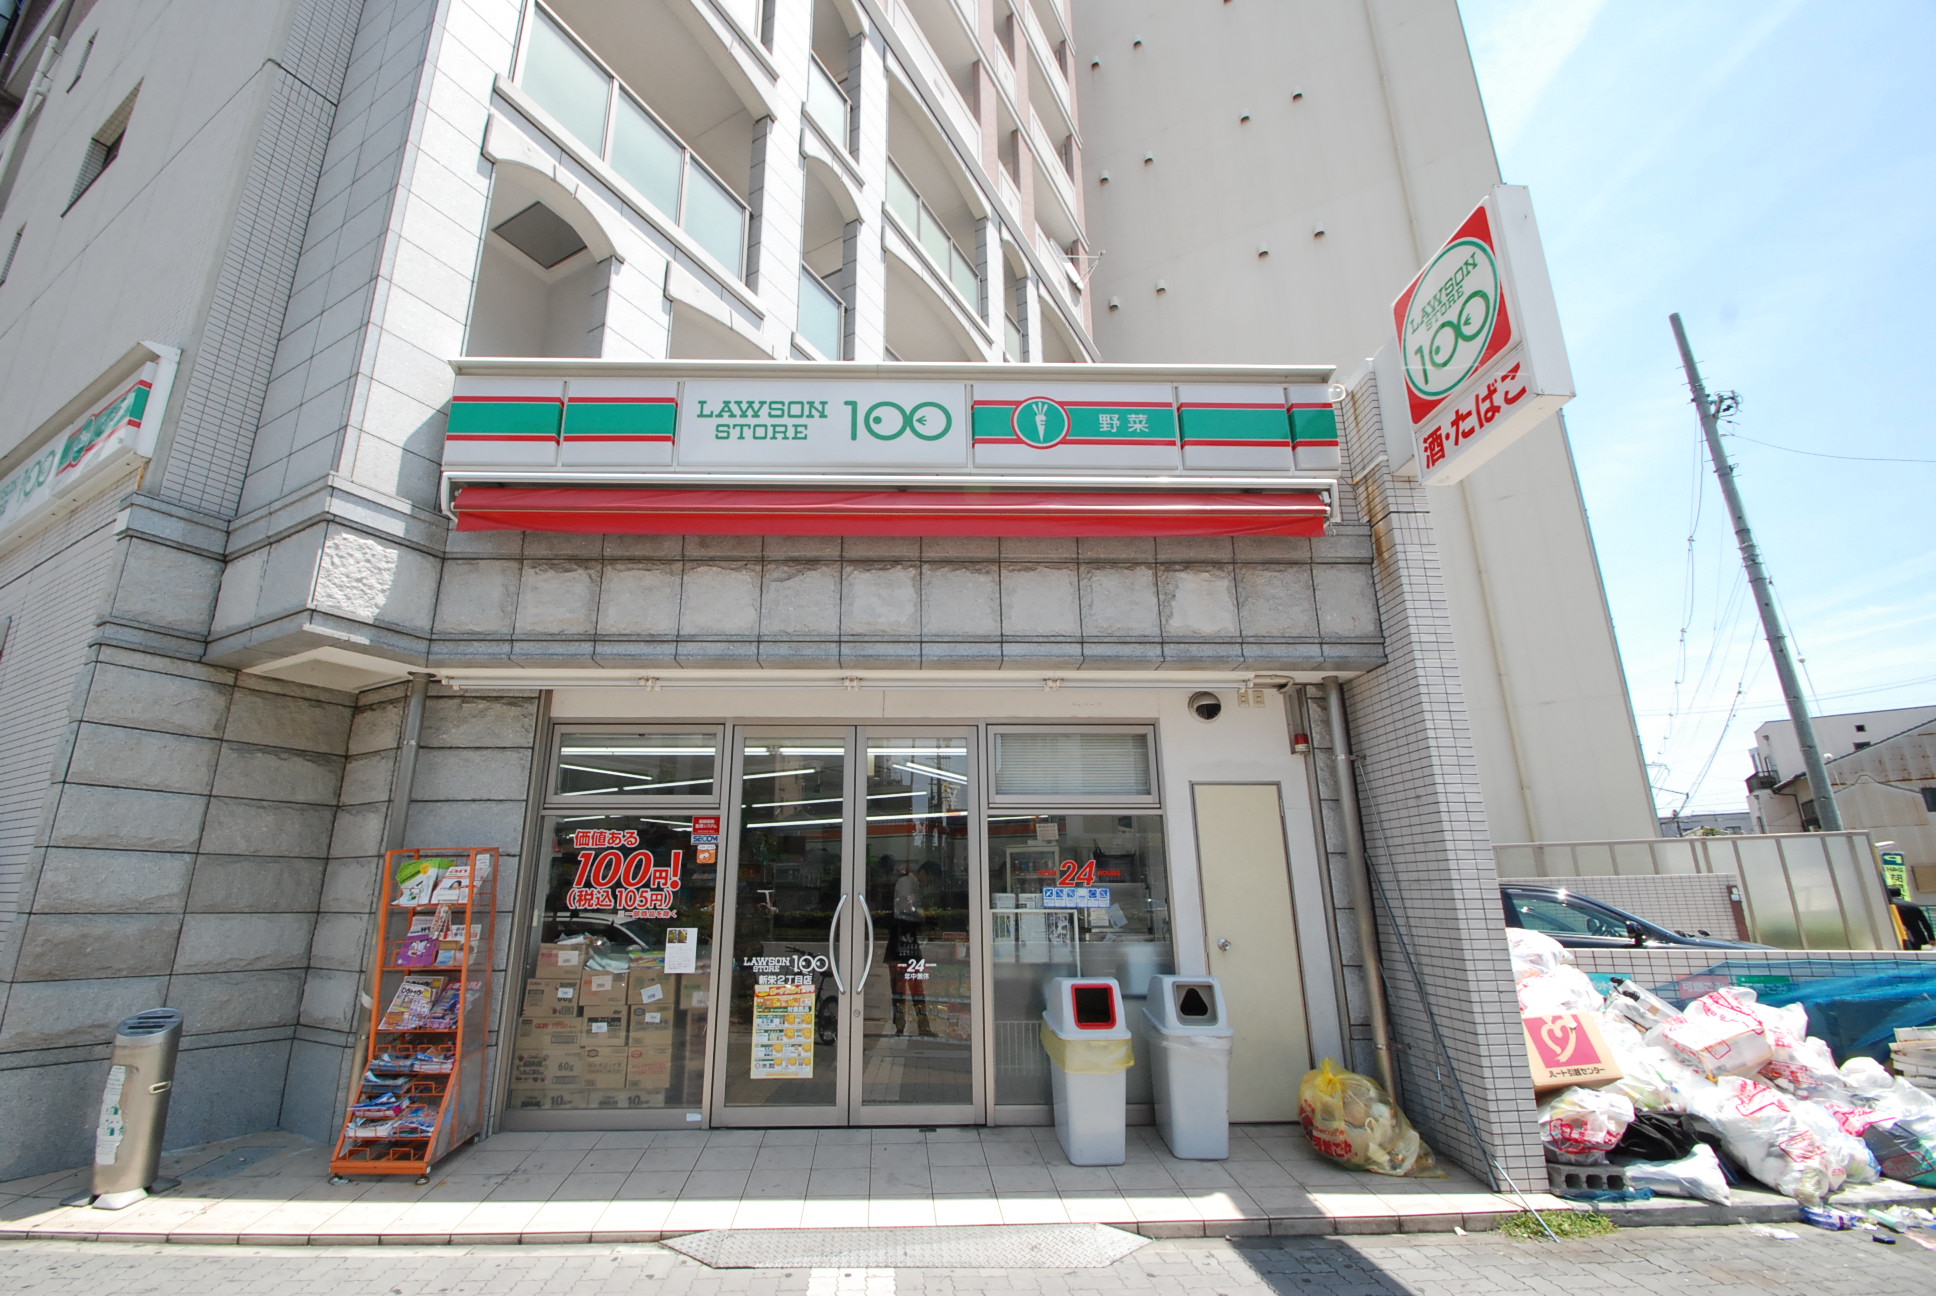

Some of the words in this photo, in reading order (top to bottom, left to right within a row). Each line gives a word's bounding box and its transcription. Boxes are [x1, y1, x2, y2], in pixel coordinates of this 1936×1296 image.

[1410, 252, 1478, 334] LAWSON
[1425, 285, 1464, 332] STORE
[1414, 289, 1491, 386] 100
[696, 400, 829, 420] LAWSON
[844, 400, 953, 442] 100
[1098, 413, 1150, 433] 野菜
[714, 423, 809, 441] STORE
[574, 829, 639, 848] 価値ある
[693, 835, 719, 843] SECOM
[1057, 859, 1096, 887] 24
[743, 957, 791, 966] LAWSON
[792, 955, 829, 973] 100
[753, 965, 780, 973] STORE
